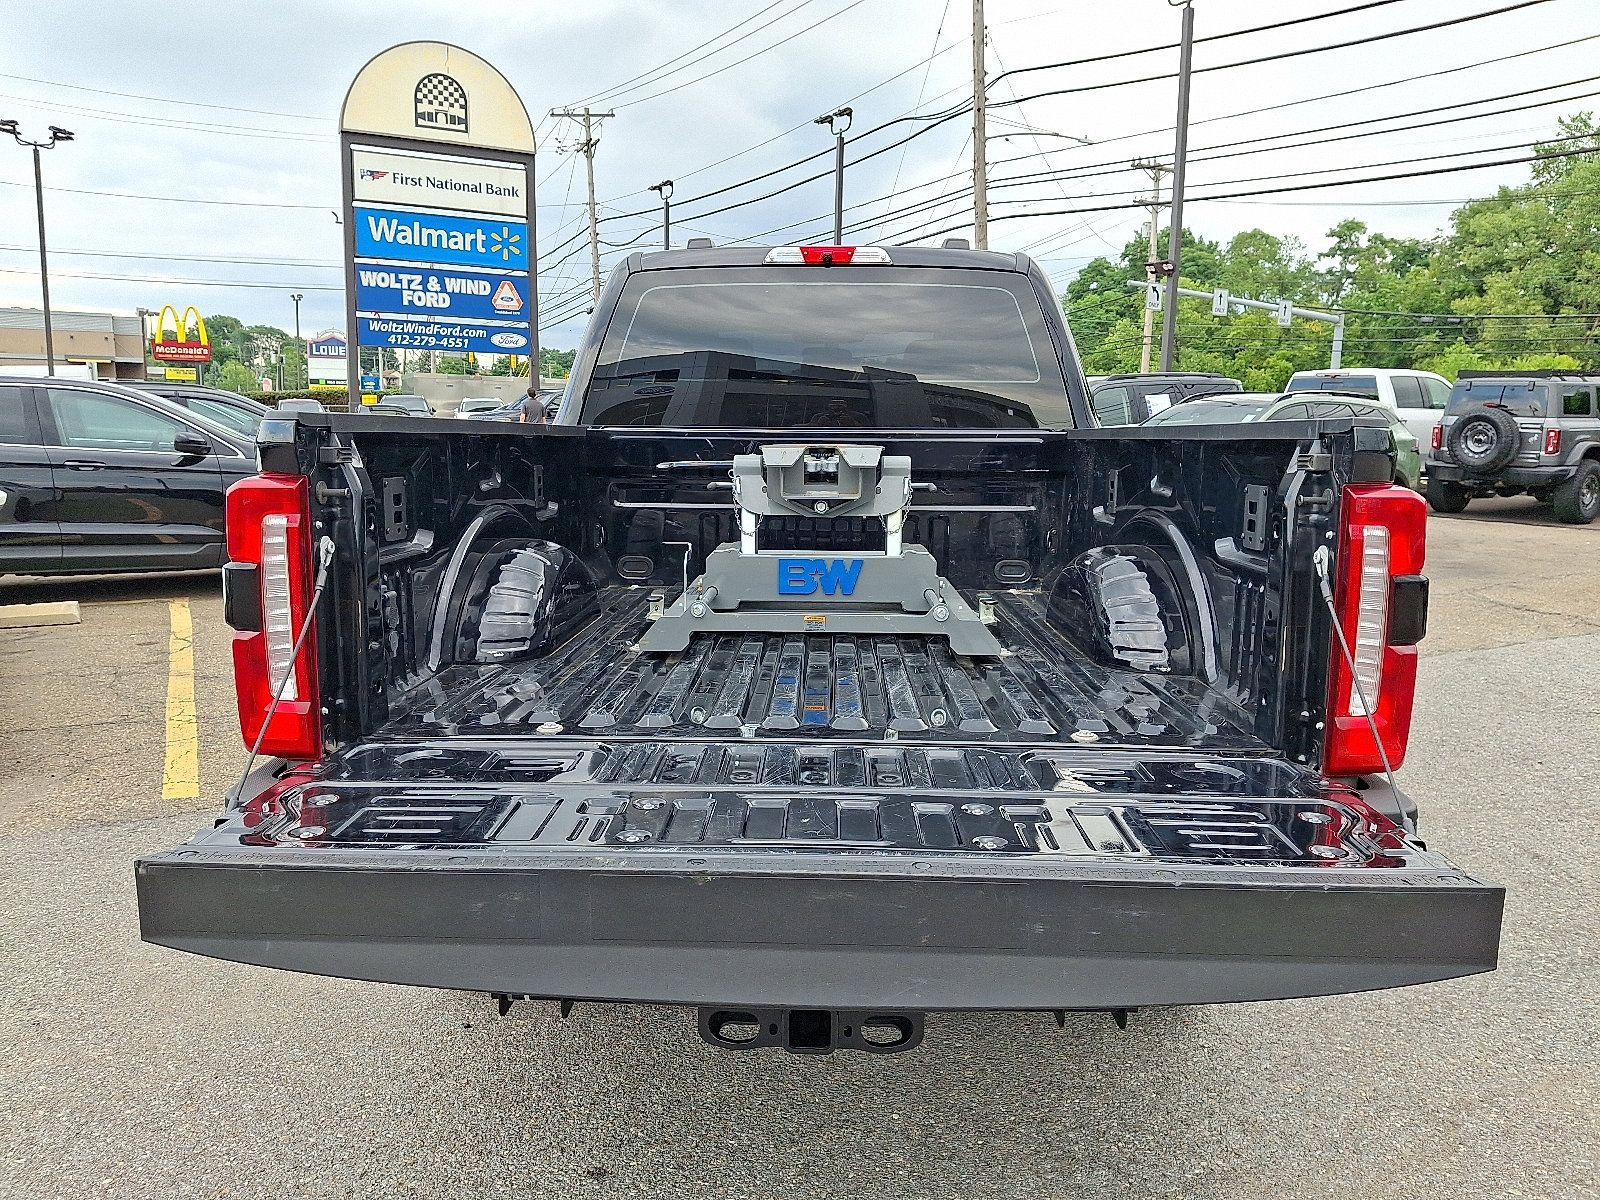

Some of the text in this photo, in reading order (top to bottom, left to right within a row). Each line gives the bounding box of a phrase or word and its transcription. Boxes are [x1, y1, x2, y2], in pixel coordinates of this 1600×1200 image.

[392, 172, 520, 198] First National Bank
[367, 215, 487, 253] Walmart
[359, 270, 491, 296] WOLTZ & WIND
[402, 289, 451, 308] FORD
[369, 320, 487, 338] WoltzWindFord.com
[387, 334, 469, 349] 412-279-4551
[498, 335, 520, 346] Ford
[155, 345, 209, 355] McDonald's
